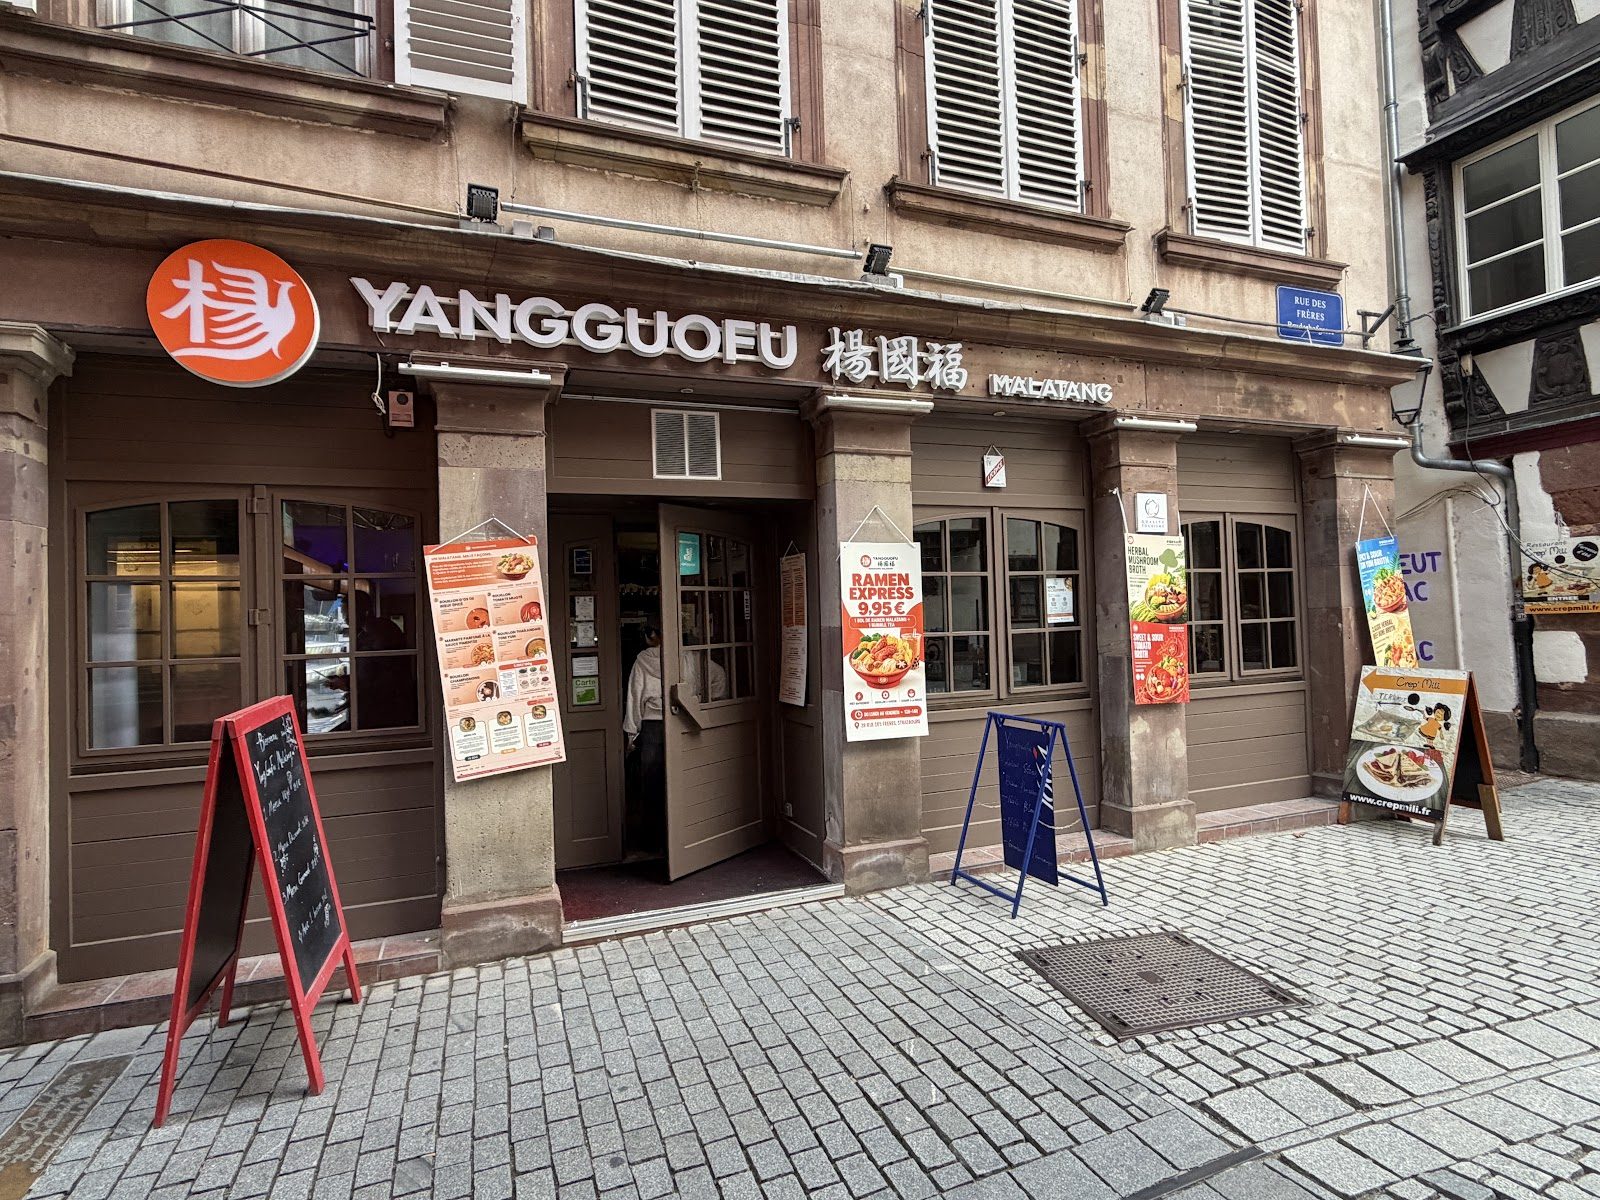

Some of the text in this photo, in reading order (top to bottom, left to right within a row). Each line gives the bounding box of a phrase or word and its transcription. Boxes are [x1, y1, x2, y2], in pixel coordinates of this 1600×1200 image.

[1294, 296, 1326, 309] RUE DES
[1296, 308, 1325, 322] FRÈRES
[349, 277, 798, 370] YANGGUOFU
[821, 327, 968, 392] 楊國福
[989, 373, 1113, 405] MALATANG
[1127, 546, 1149, 556] HERBAL
[1128, 555, 1159, 566] MUSHROOM
[1129, 565, 1147, 575] BROTH
[852, 573, 910, 586] RAMEN
[849, 587, 914, 600] EXPRESS
[1529, 604, 1599, 613] www.crepmili.fr
[575, 679, 596, 687] Carte
[1350, 793, 1432, 816] www.crepmili.fr
